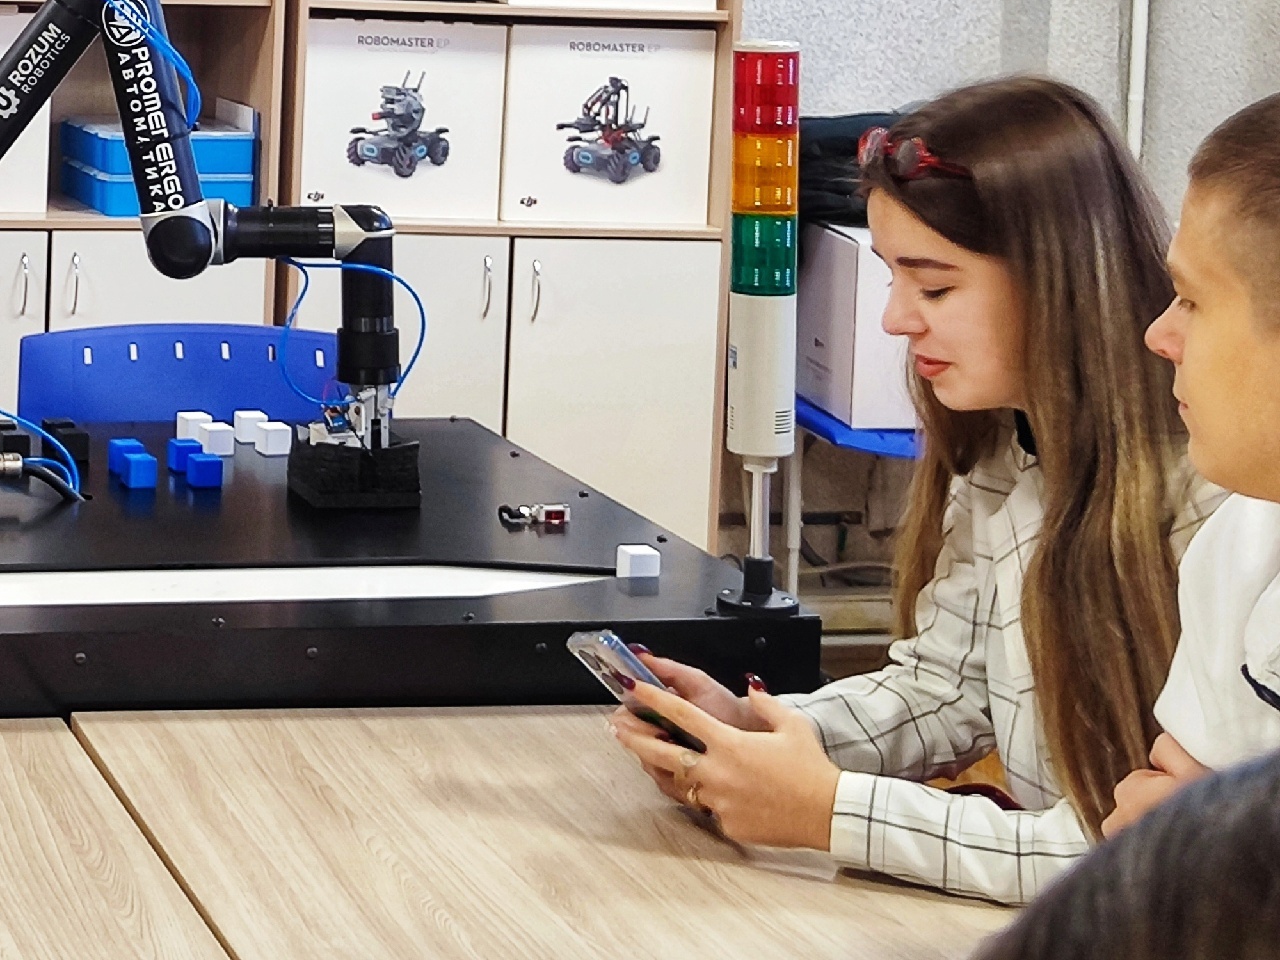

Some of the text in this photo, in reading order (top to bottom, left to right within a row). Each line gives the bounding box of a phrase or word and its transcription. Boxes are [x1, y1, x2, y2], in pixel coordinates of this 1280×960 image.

[7, 22, 62, 87] ROZUM
[357, 35, 434, 48] ROBOMASTER
[569, 41, 645, 53] ROBOMASTER
[21, 33, 71, 94] ROBOTICS
